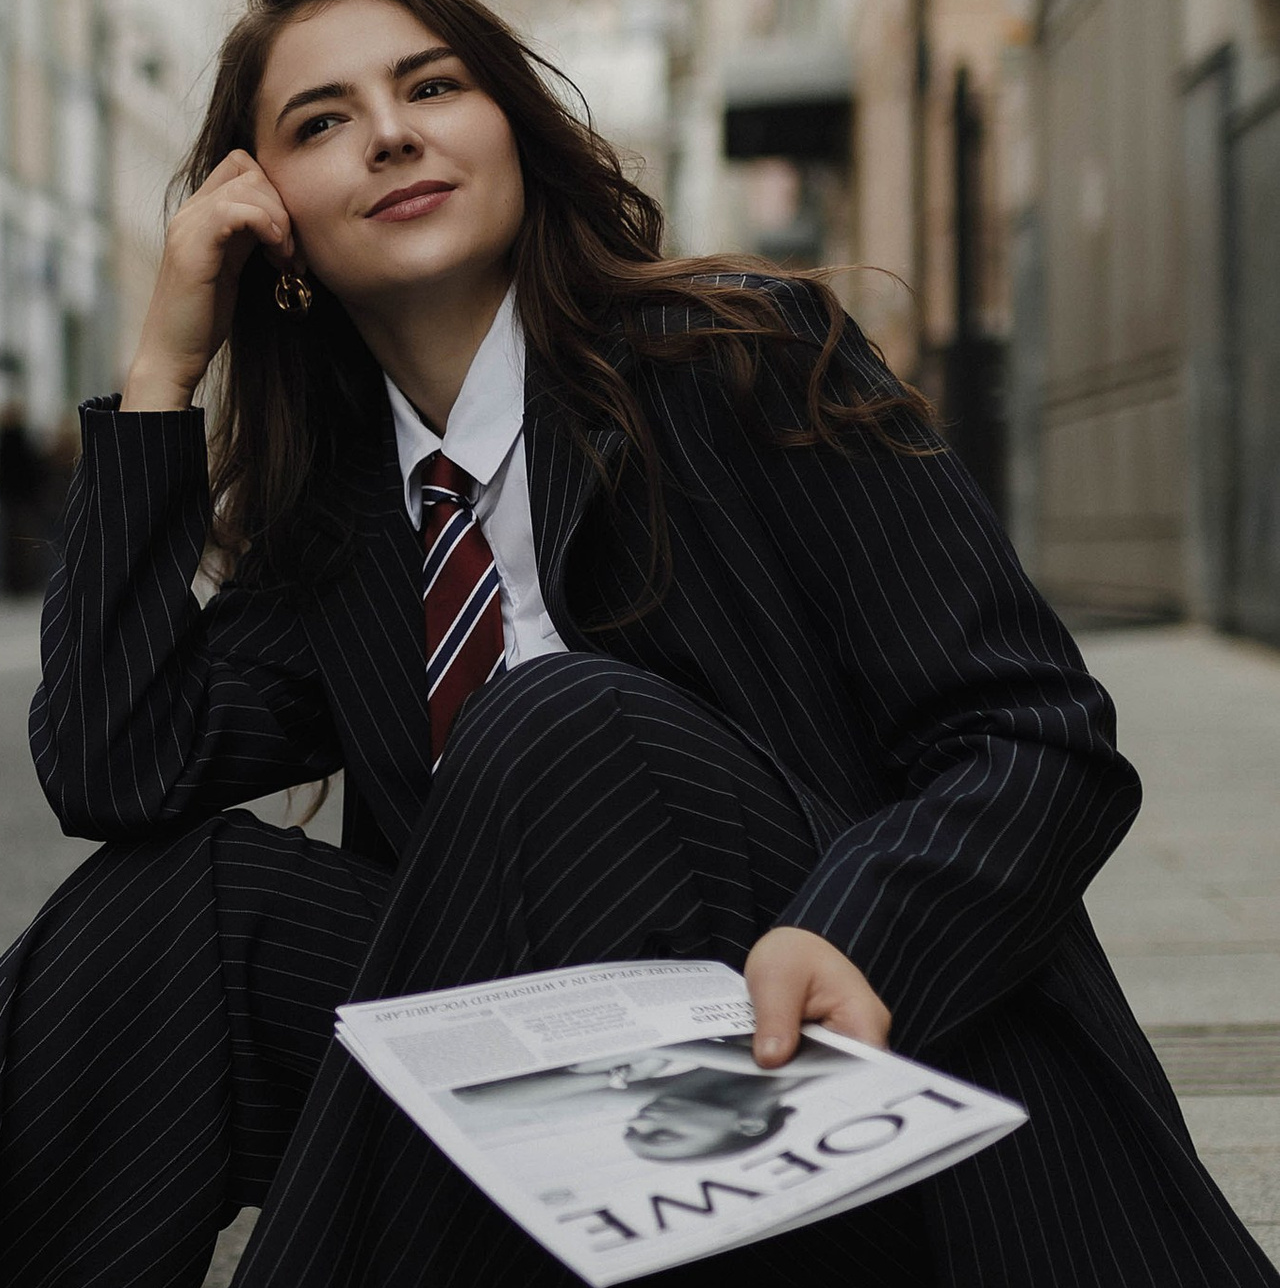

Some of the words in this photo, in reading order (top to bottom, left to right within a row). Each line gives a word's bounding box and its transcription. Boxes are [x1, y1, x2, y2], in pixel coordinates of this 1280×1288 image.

[590, 969, 642, 983] SPEAKS
[646, 966, 709, 977] TEXTURE
[571, 976, 589, 986] IN
[468, 982, 556, 1006] WHISPERED
[374, 1000, 468, 1023] VOCABULARY
[556, 1086, 967, 1253] LOEWE
